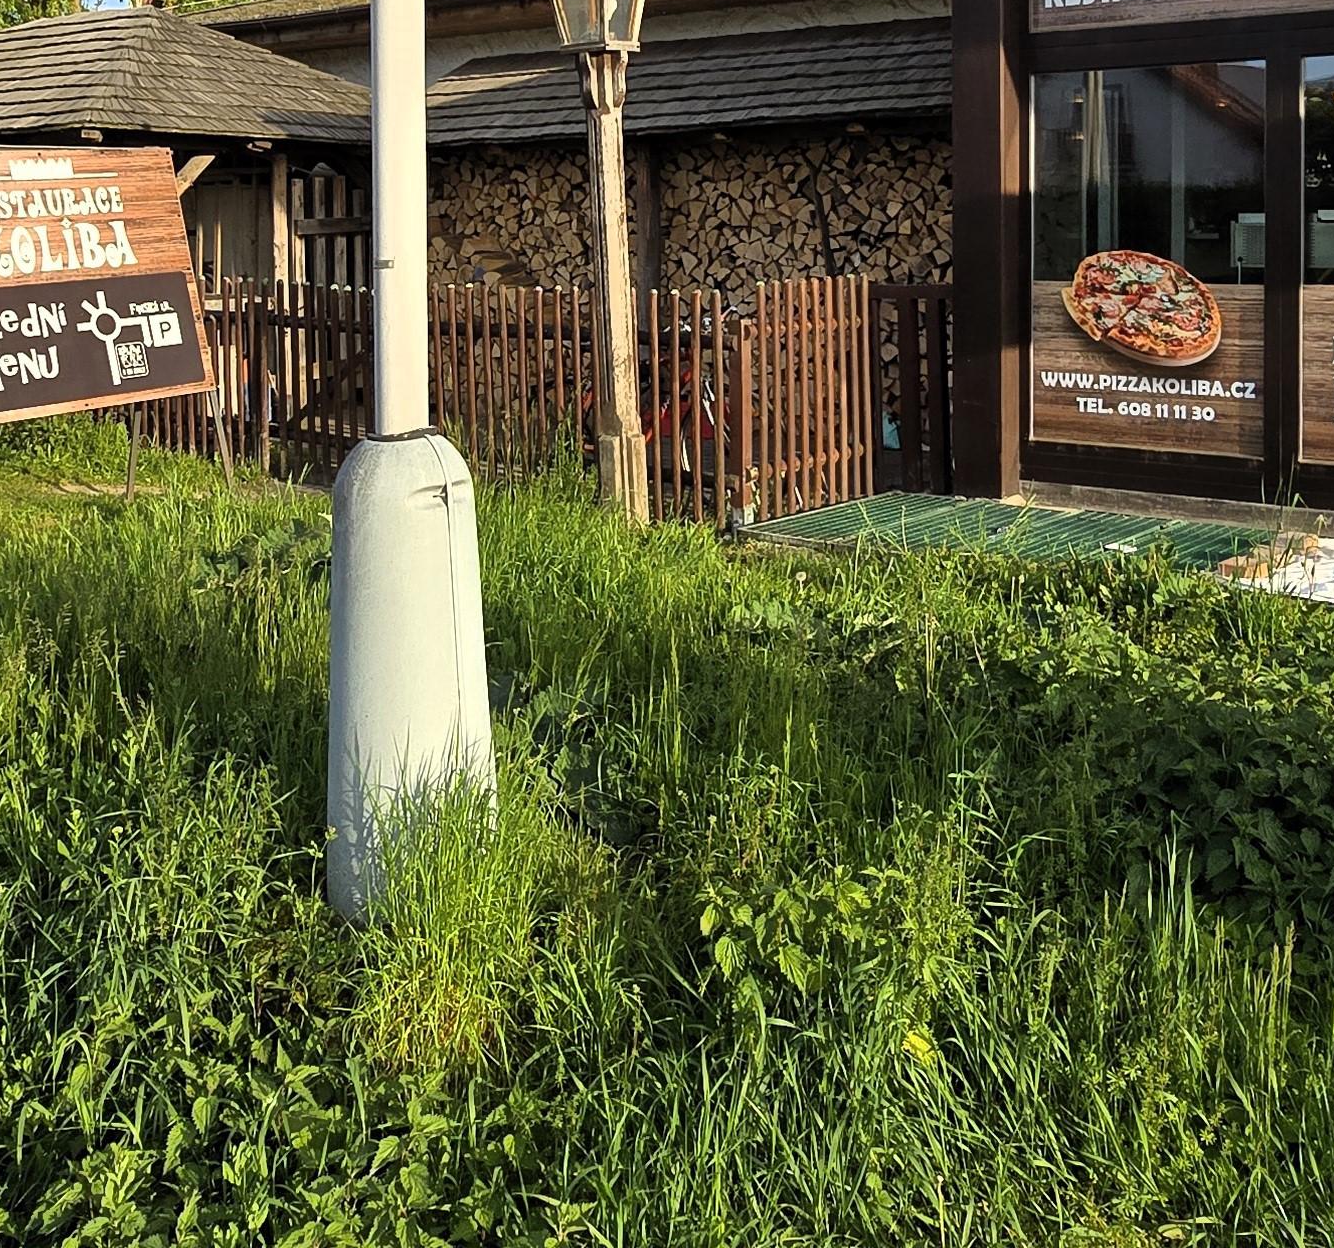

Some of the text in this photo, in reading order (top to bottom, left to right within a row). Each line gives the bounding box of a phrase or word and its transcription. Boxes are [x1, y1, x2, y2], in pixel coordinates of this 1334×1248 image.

[1040, 371, 1256, 399] WWW.PIZZAKOLIBA.CZ
[1076, 396, 1215, 421] TEL. 608 11 11 30
